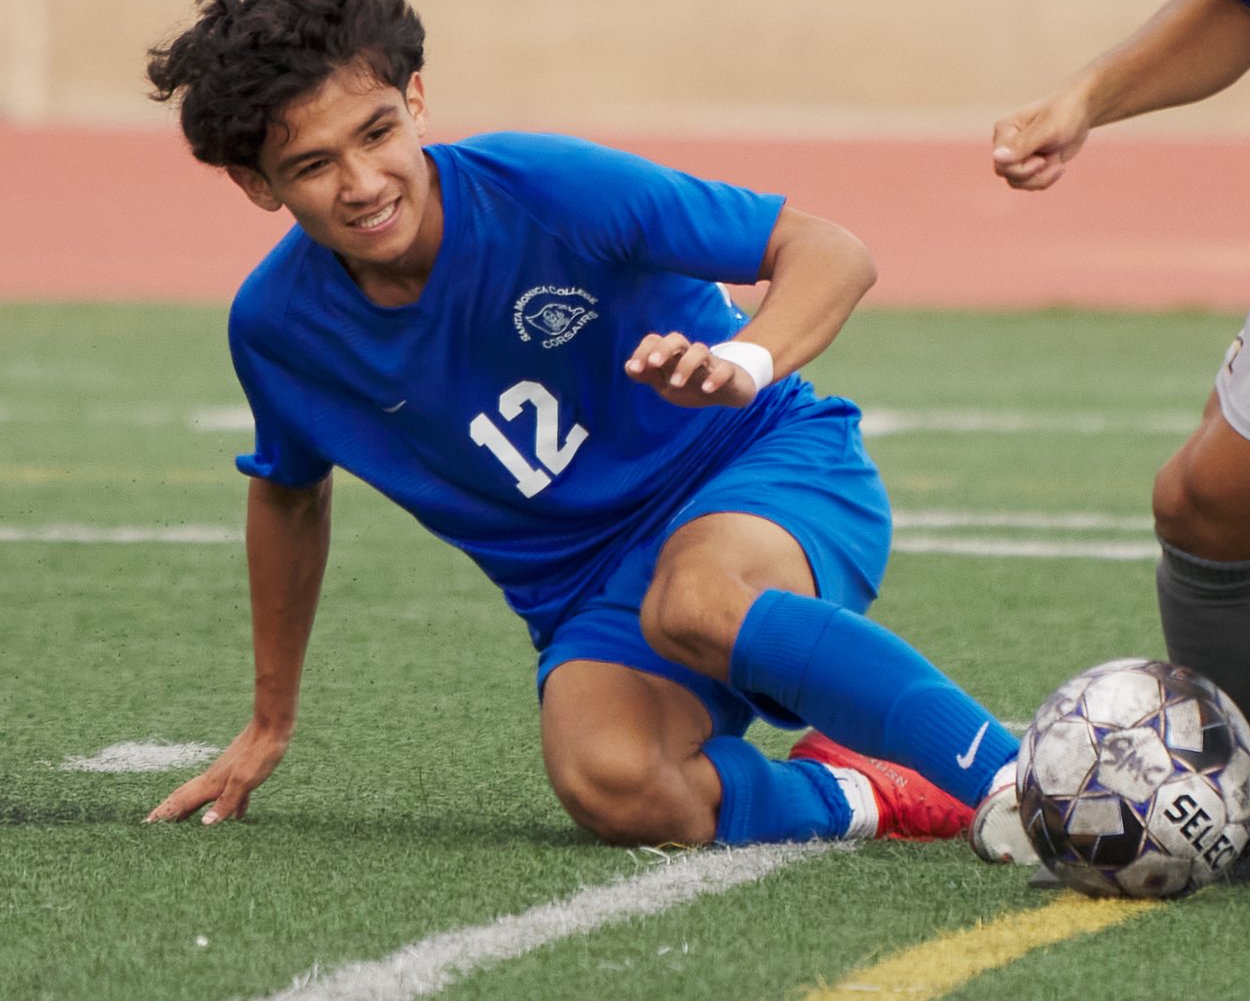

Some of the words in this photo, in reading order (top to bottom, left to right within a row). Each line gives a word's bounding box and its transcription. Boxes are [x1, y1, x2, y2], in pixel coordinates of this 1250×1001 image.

[513, 285, 549, 312] MONICA
[548, 284, 599, 305] COLLEGE
[542, 310, 599, 349] CORSAIRS
[469, 380, 589, 499] 12
